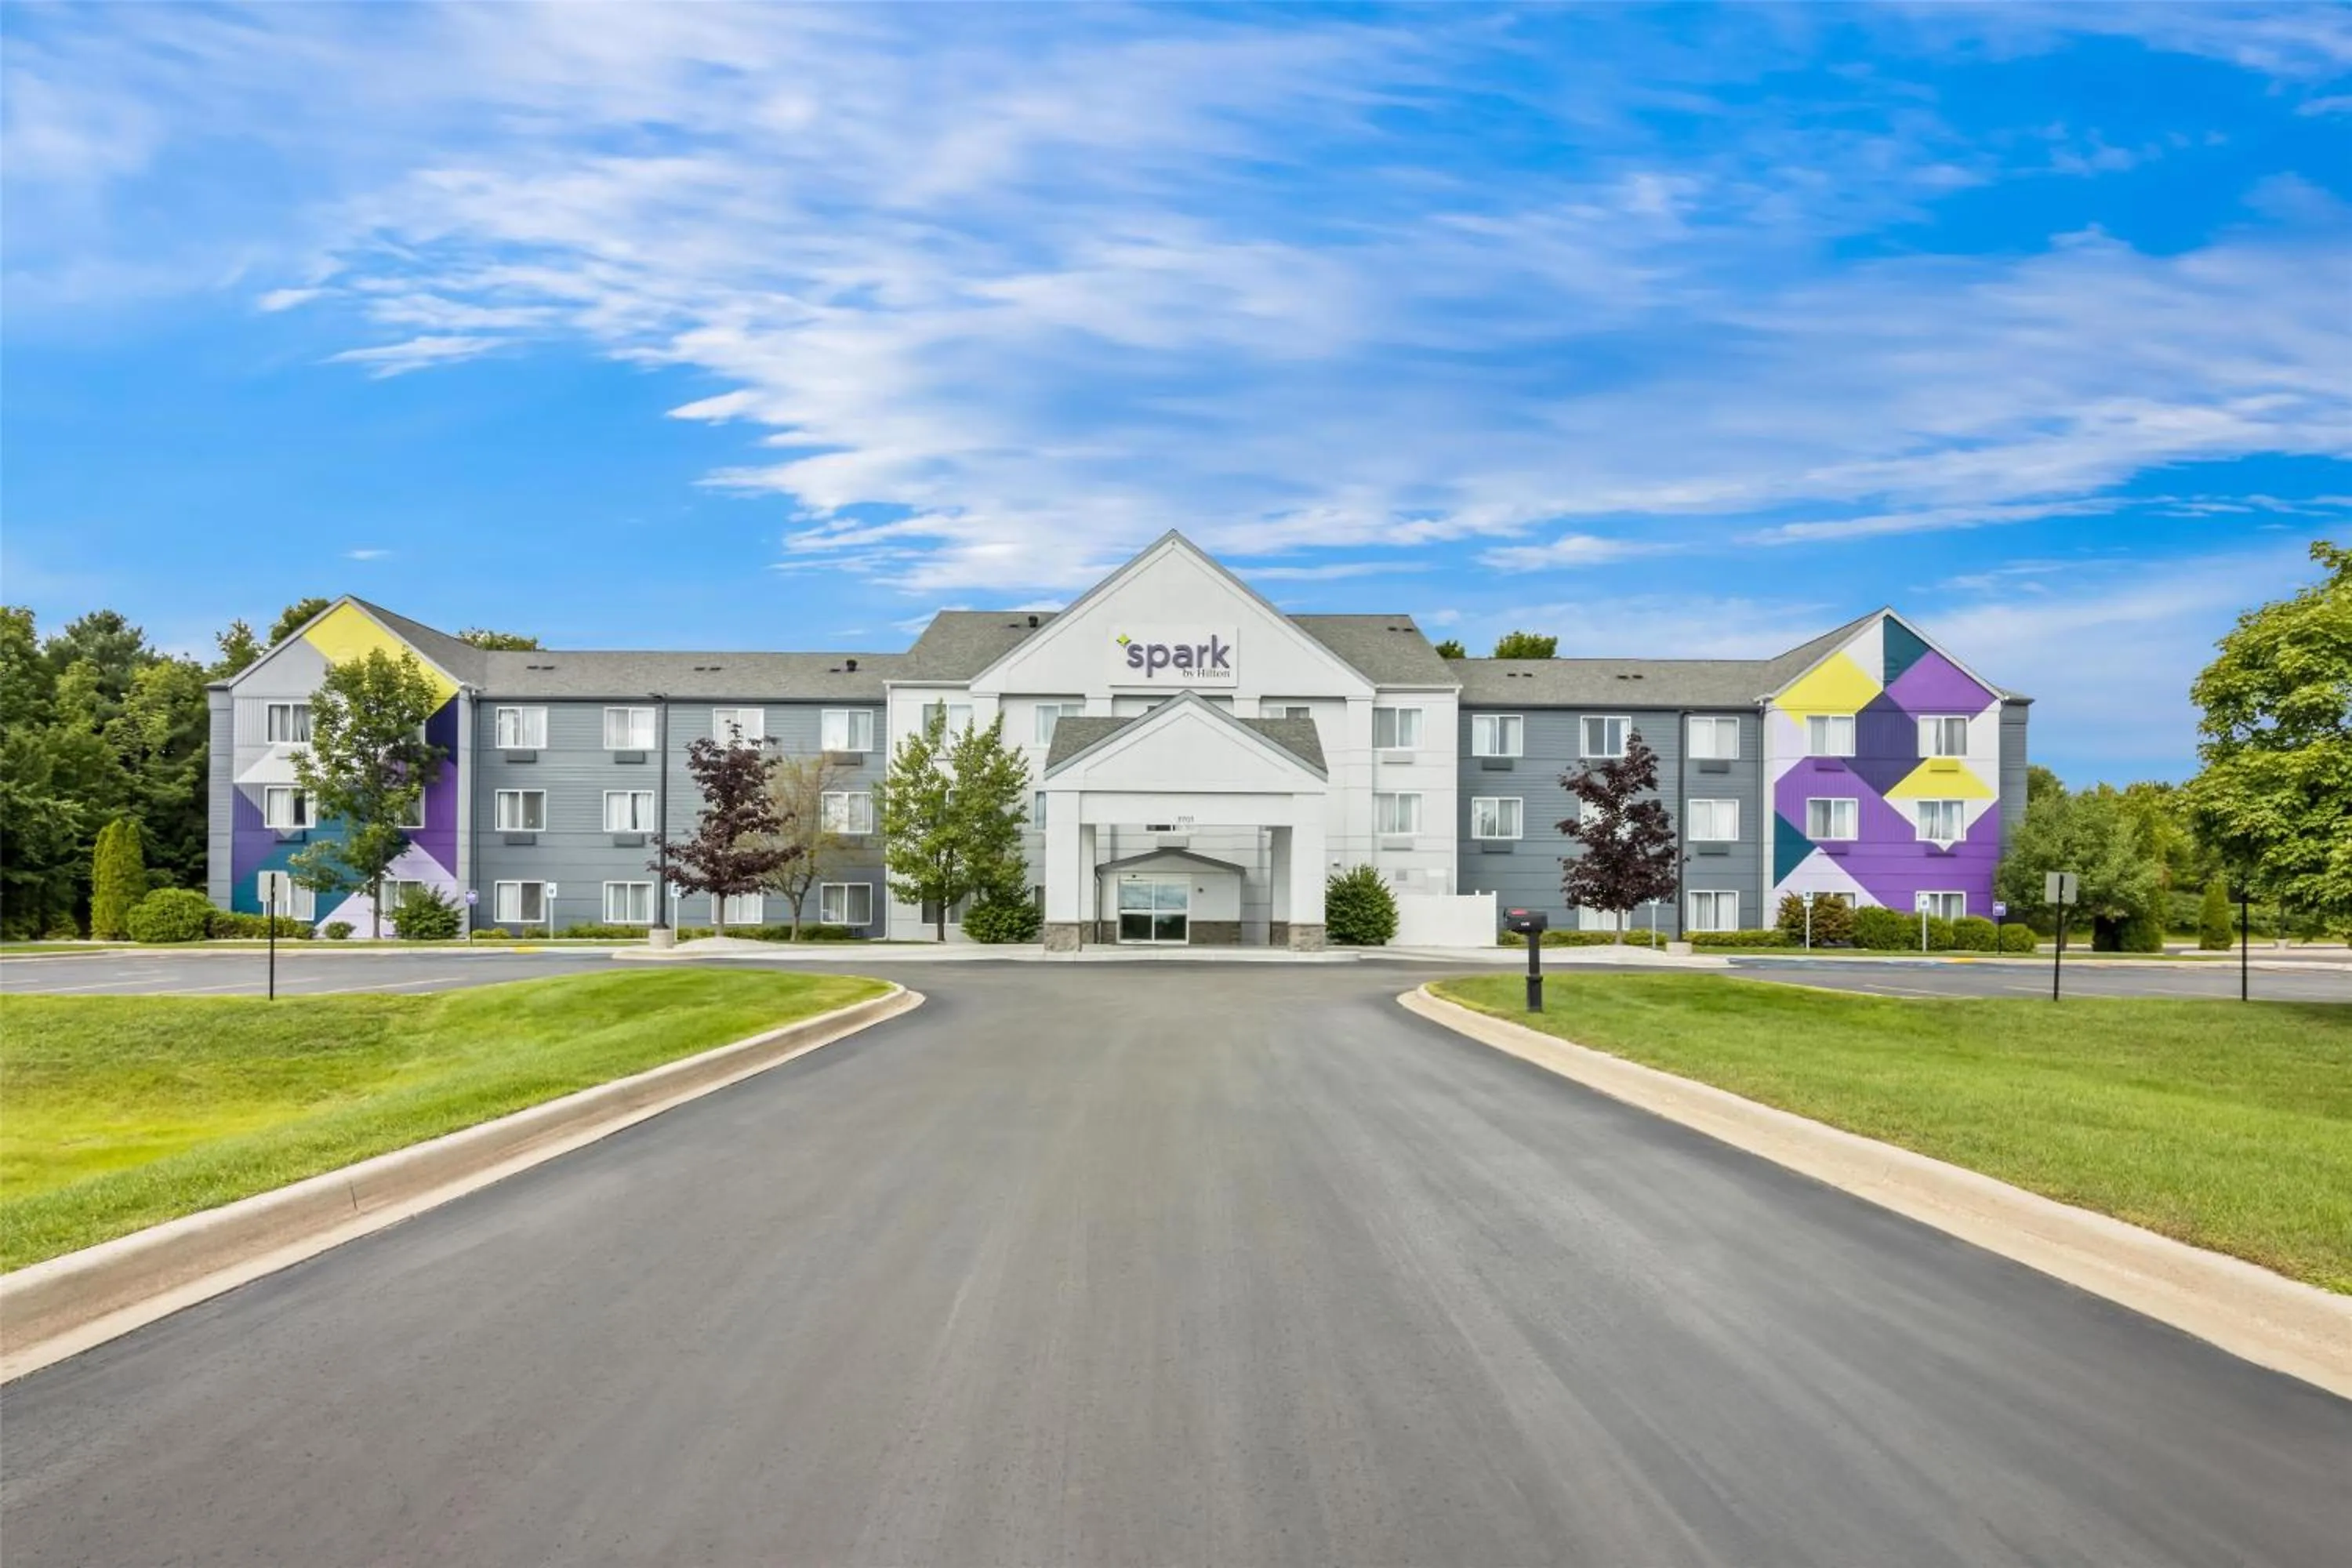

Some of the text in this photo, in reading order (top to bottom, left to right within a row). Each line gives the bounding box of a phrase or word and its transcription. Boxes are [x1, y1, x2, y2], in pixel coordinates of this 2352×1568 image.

[1127, 633, 1230, 677] spark
[1183, 669, 1230, 679] by Hilton
